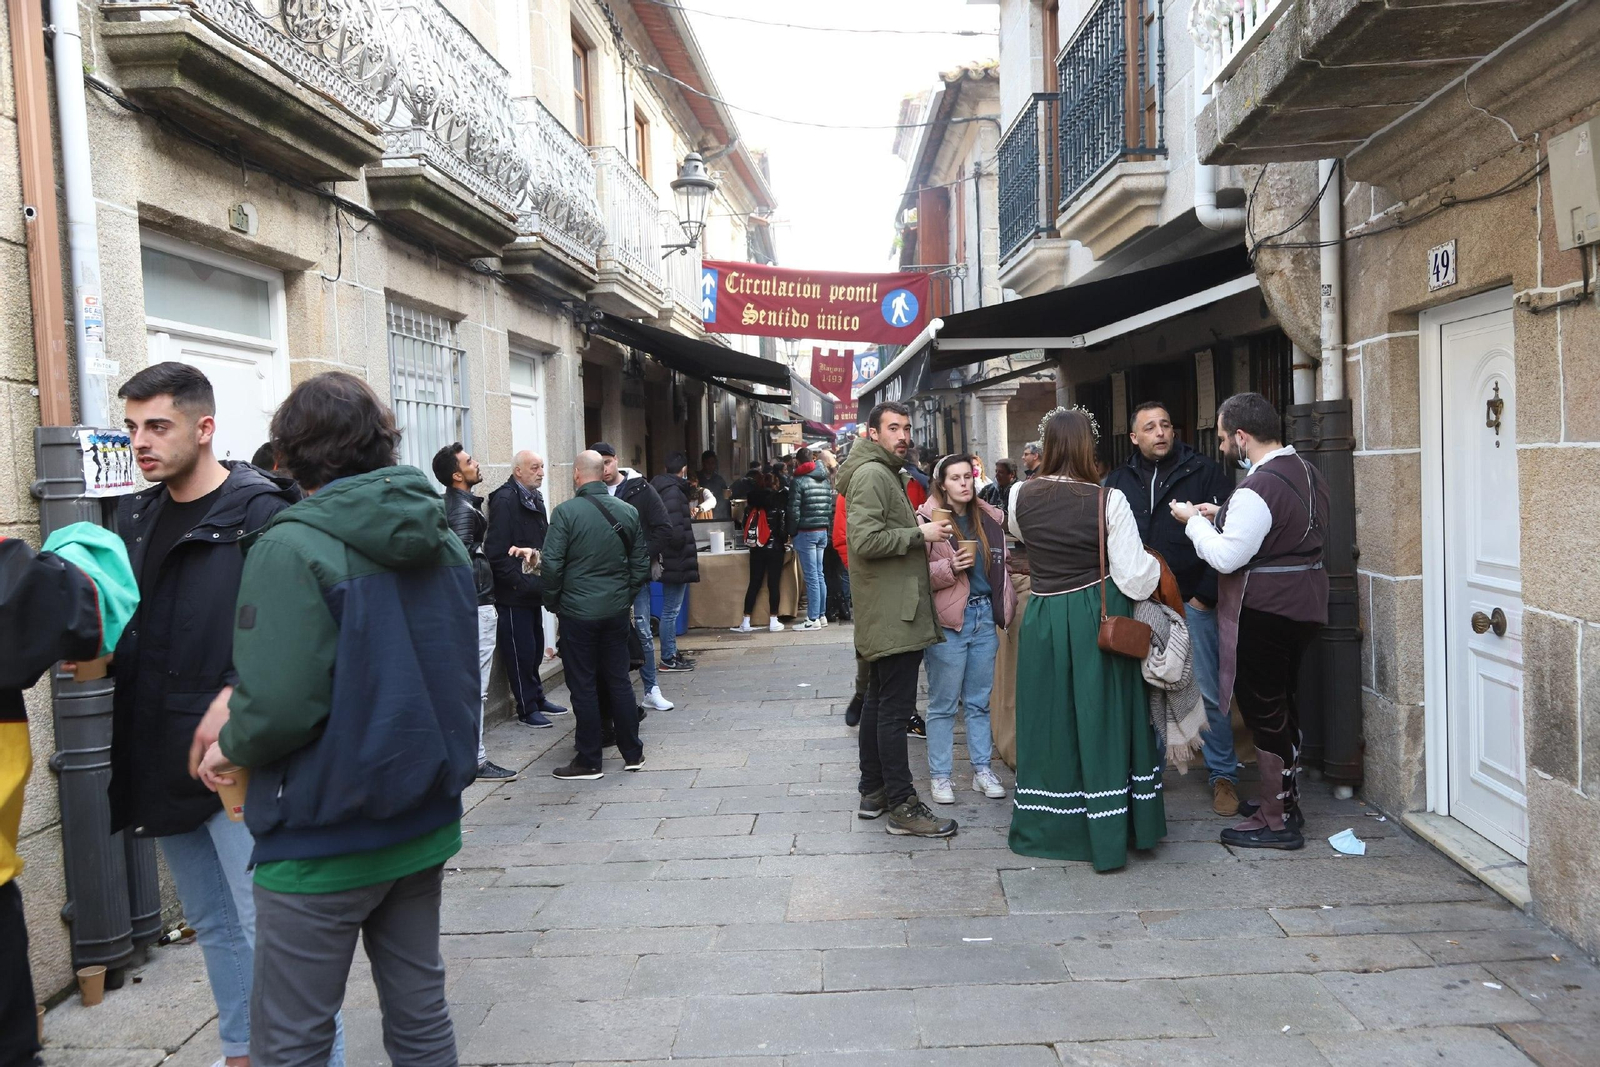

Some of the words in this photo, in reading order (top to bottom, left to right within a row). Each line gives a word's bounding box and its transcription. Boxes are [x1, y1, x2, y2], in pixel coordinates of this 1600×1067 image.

[1433, 249, 1450, 283] 49
[725, 271, 821, 299] Circulación
[741, 302, 809, 328] Sentido
[817, 307, 860, 331] único
[822, 374, 843, 384] 1493
